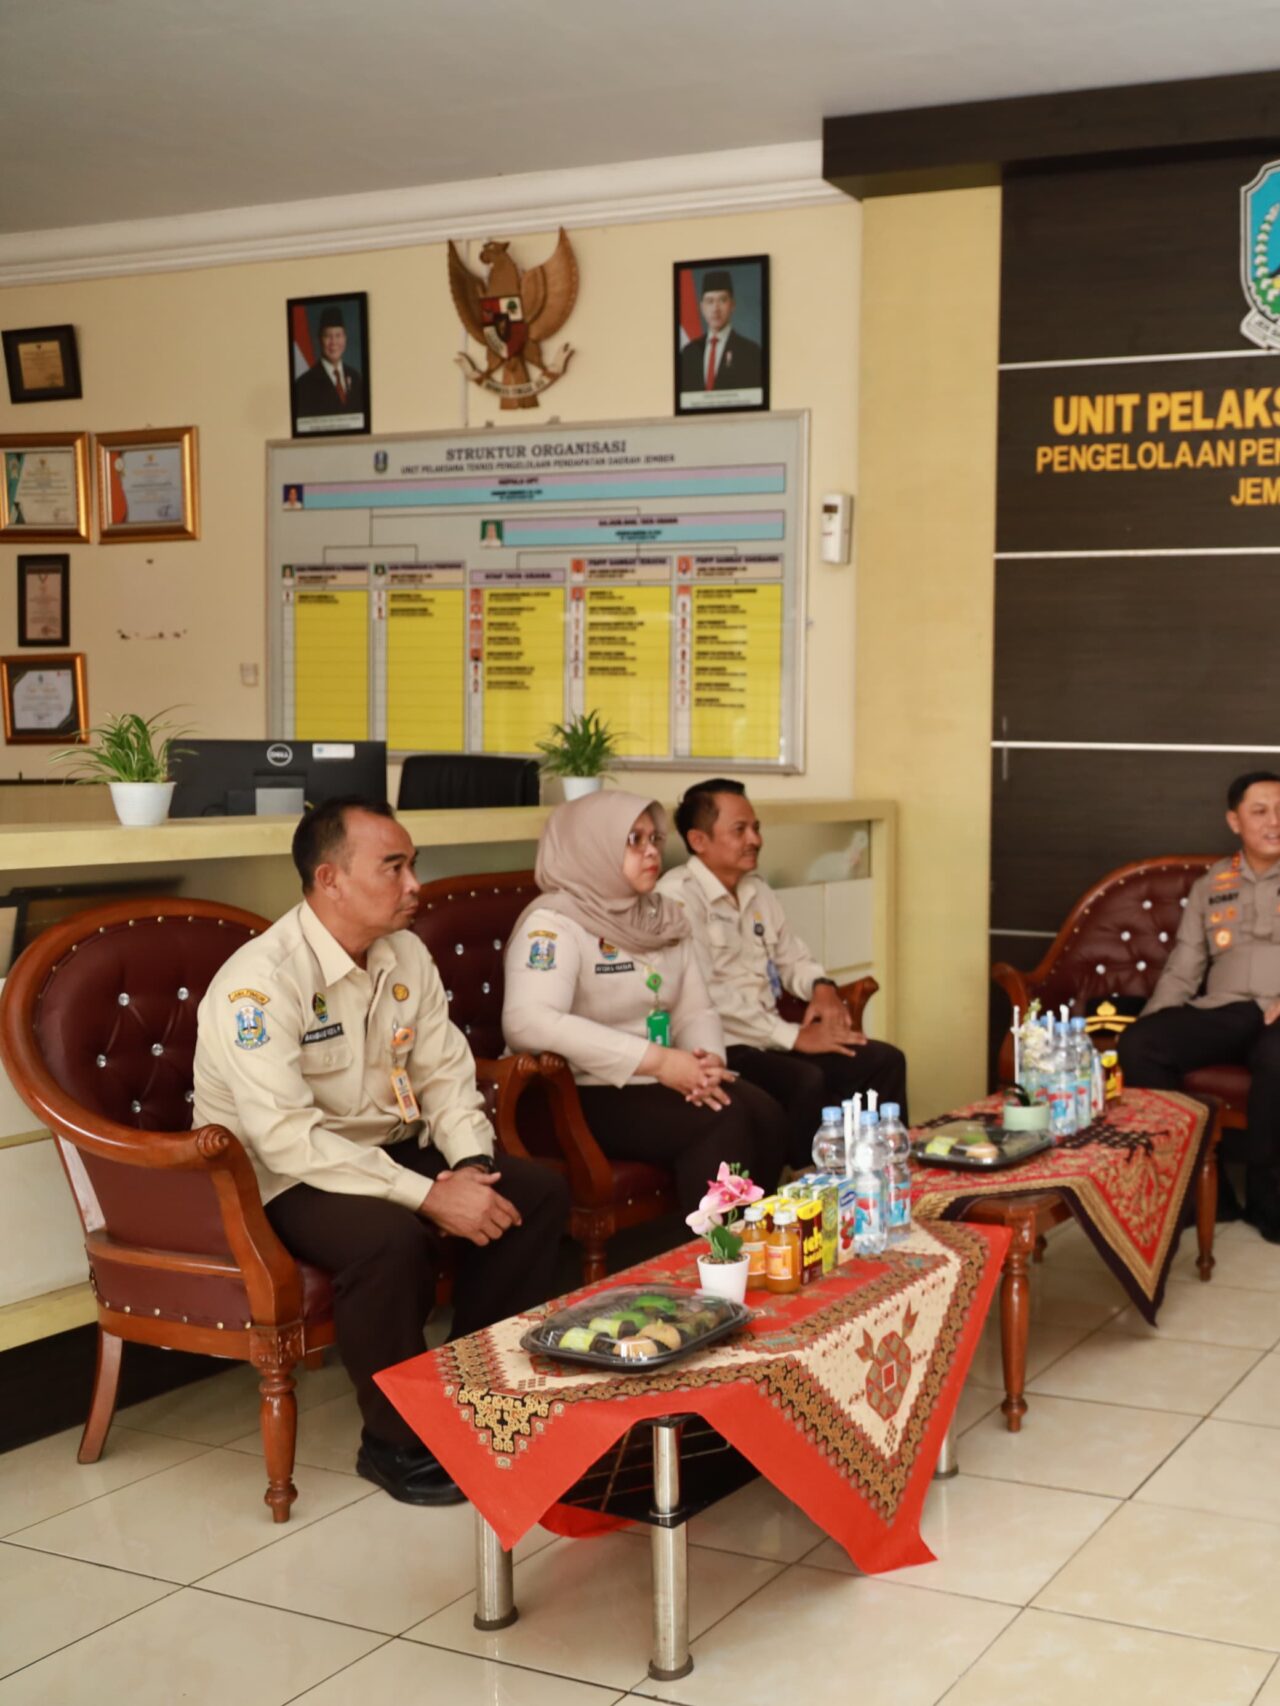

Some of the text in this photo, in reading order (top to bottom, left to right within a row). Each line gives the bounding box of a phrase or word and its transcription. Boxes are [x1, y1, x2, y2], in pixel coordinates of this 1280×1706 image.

[1053, 392, 1142, 436] UNIT
[446, 440, 627, 461] STRUKTUR ORGANISASI
[1036, 439, 1236, 473] PENGELOLAAN
